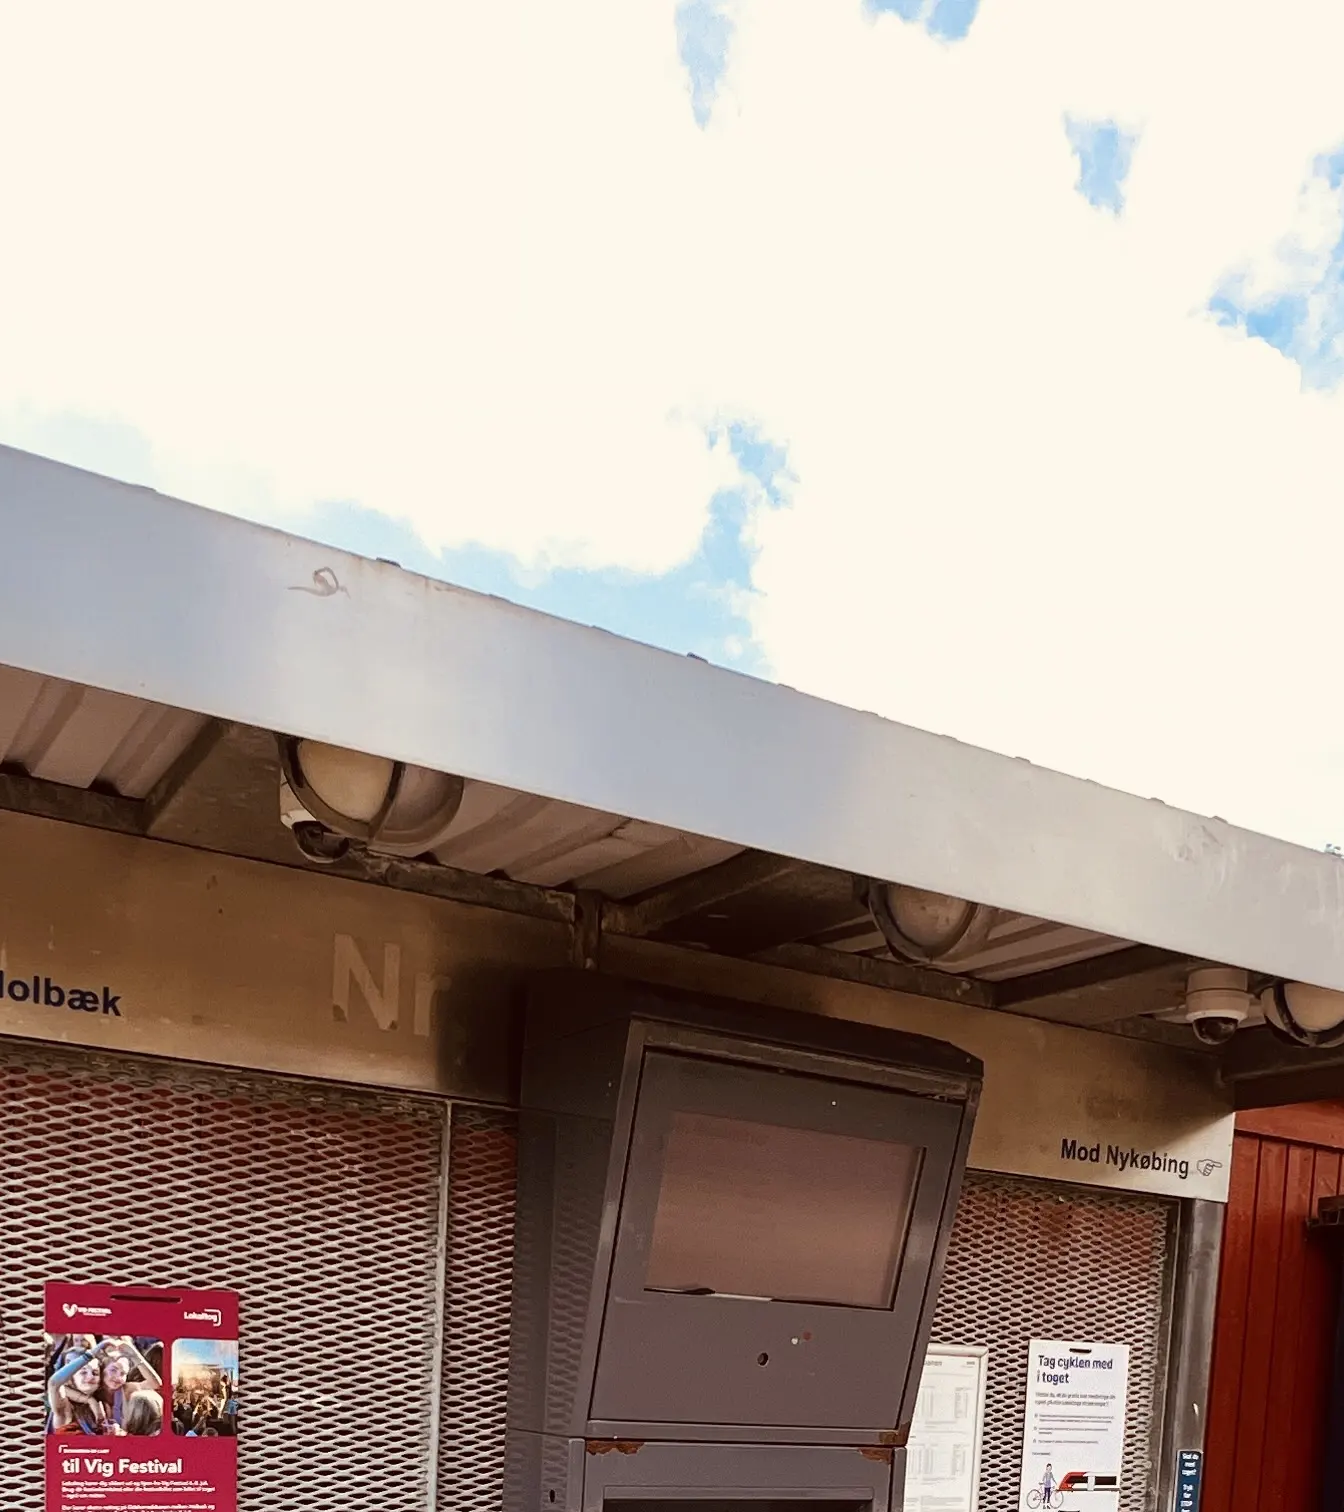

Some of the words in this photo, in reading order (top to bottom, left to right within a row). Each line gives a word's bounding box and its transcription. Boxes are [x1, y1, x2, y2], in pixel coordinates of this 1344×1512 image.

[1060, 1138, 1100, 1163] Mod
[1106, 1144, 1189, 1179] Nykøbing
[1038, 1355, 1056, 1369] Tag
[1057, 1356, 1091, 1370] cyklen
[1092, 1358, 1114, 1369] med
[1036, 1369, 1041, 1382] i
[1042, 1372, 1070, 1385] toget
[61, 1458, 80, 1473] til
[84, 1458, 114, 1477] Vig
[118, 1458, 183, 1474] Festival
